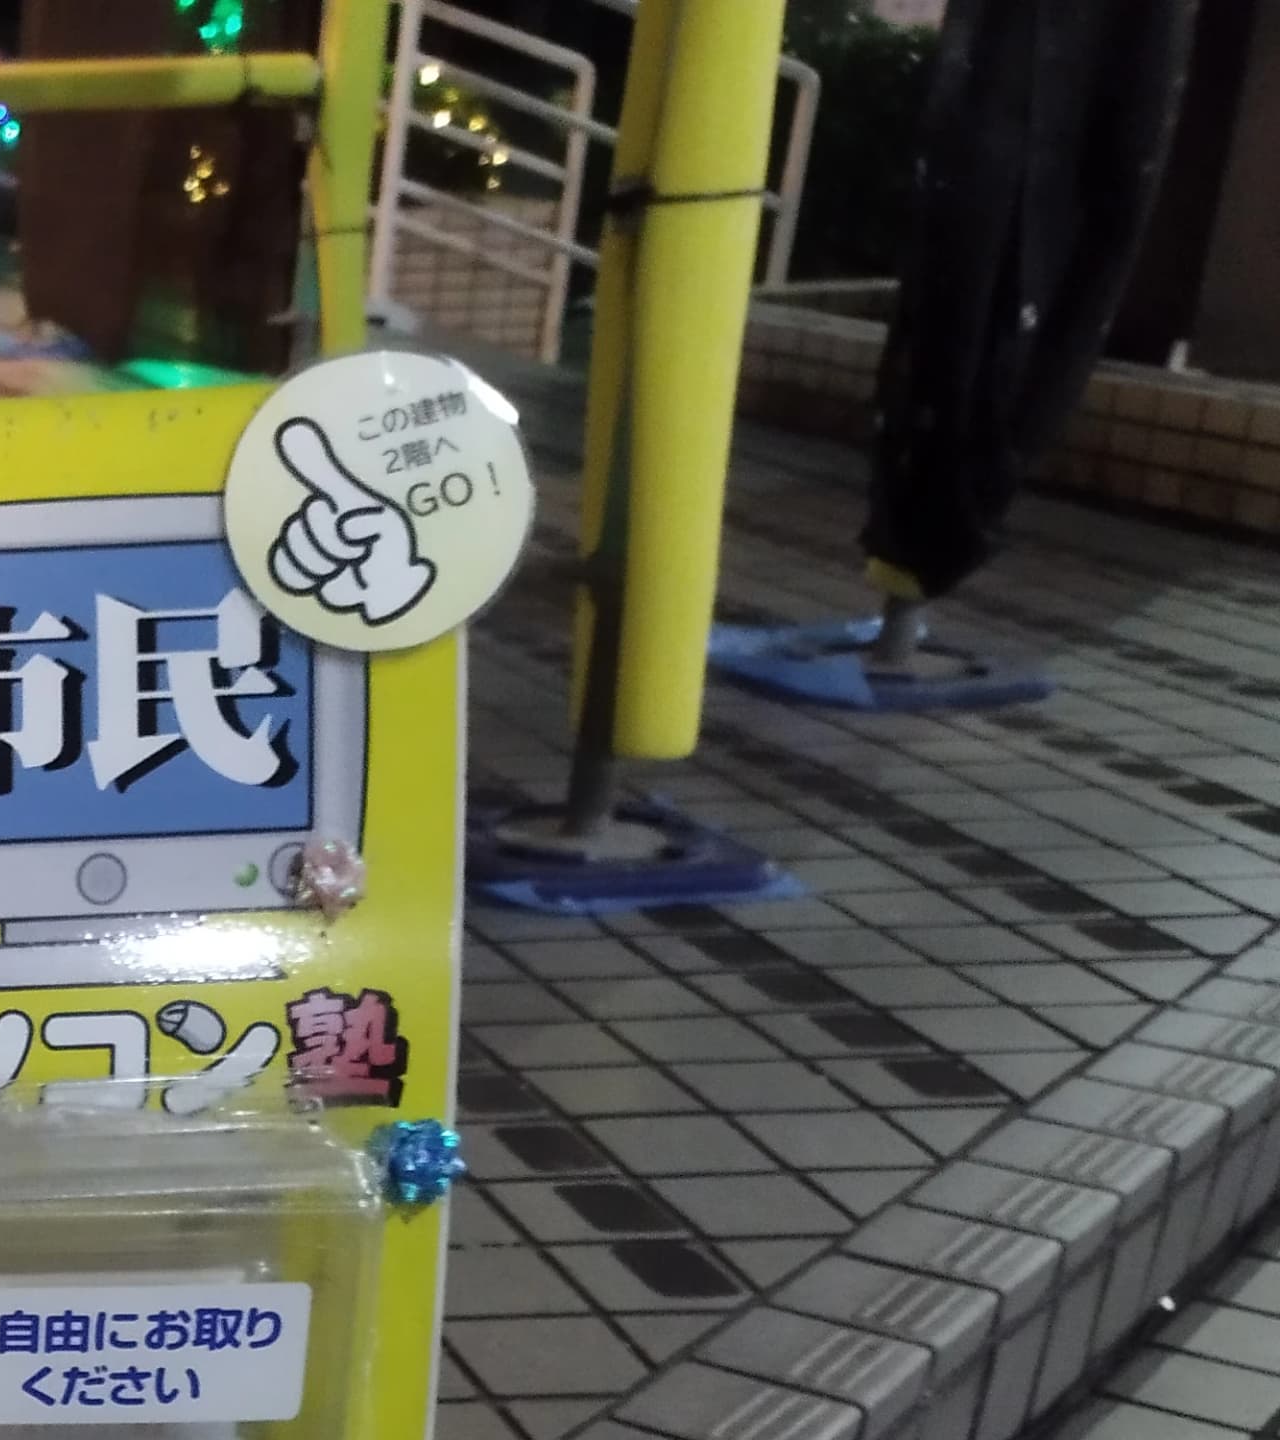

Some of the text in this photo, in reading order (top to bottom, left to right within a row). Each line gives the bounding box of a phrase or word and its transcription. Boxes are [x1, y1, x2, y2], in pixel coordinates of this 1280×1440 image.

[356, 391, 467, 442] この建物
[382, 436, 460, 475] 2階へ
[21, 1365, 201, 1406] ください
